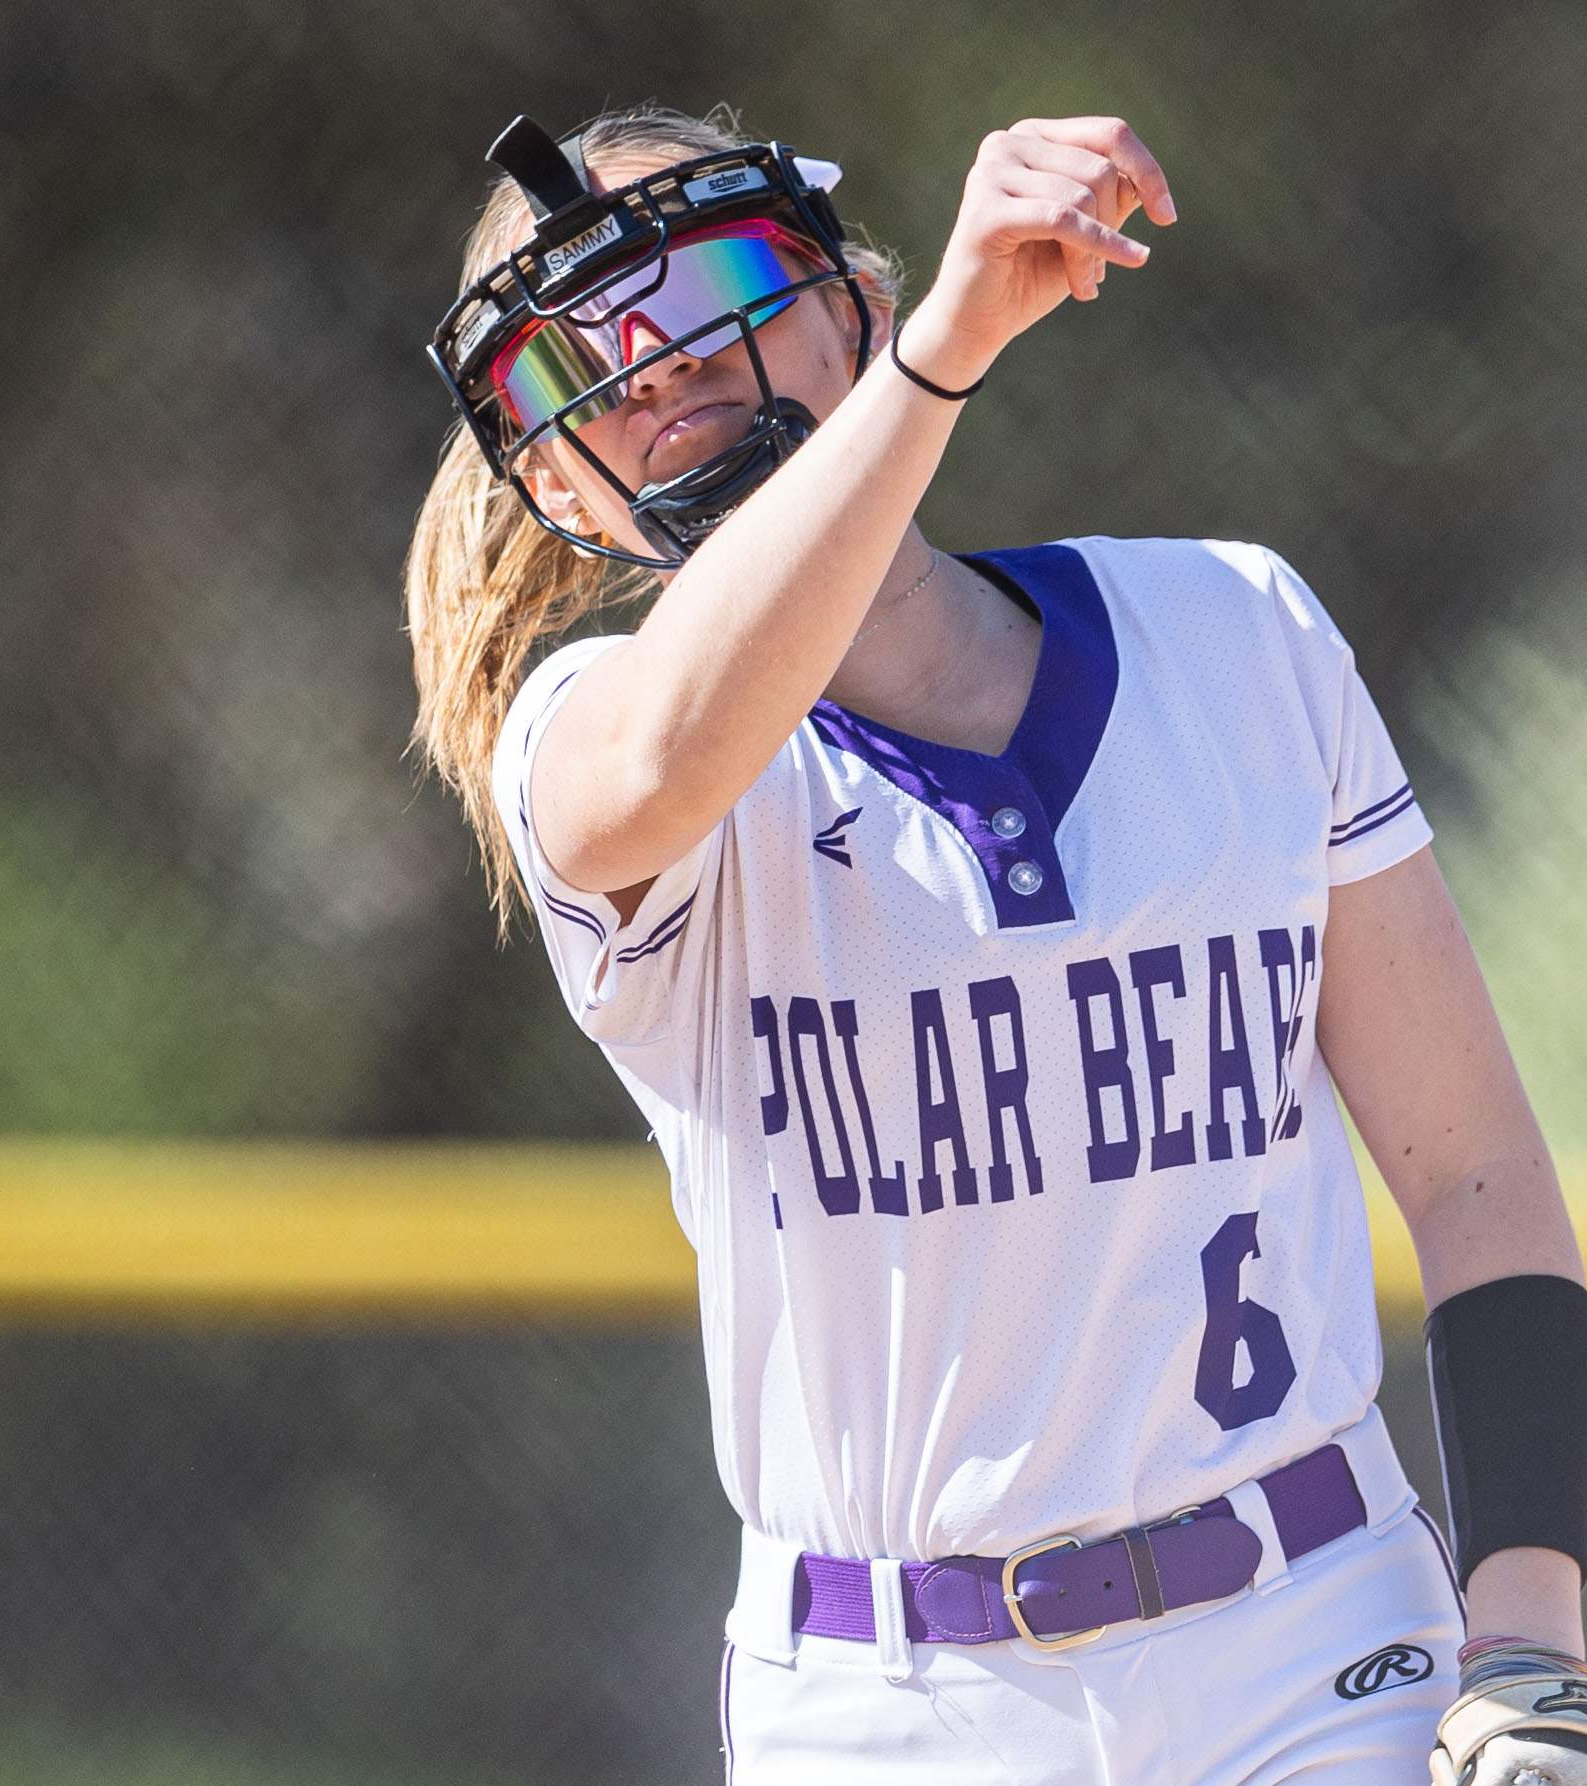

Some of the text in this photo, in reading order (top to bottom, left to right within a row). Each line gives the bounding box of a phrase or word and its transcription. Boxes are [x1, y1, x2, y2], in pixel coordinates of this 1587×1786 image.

[549, 219, 615, 271] SAMMY
[708, 172, 748, 191] schutt
[750, 975, 1044, 1230] POLAR
[1194, 1211, 1297, 1432] 6
